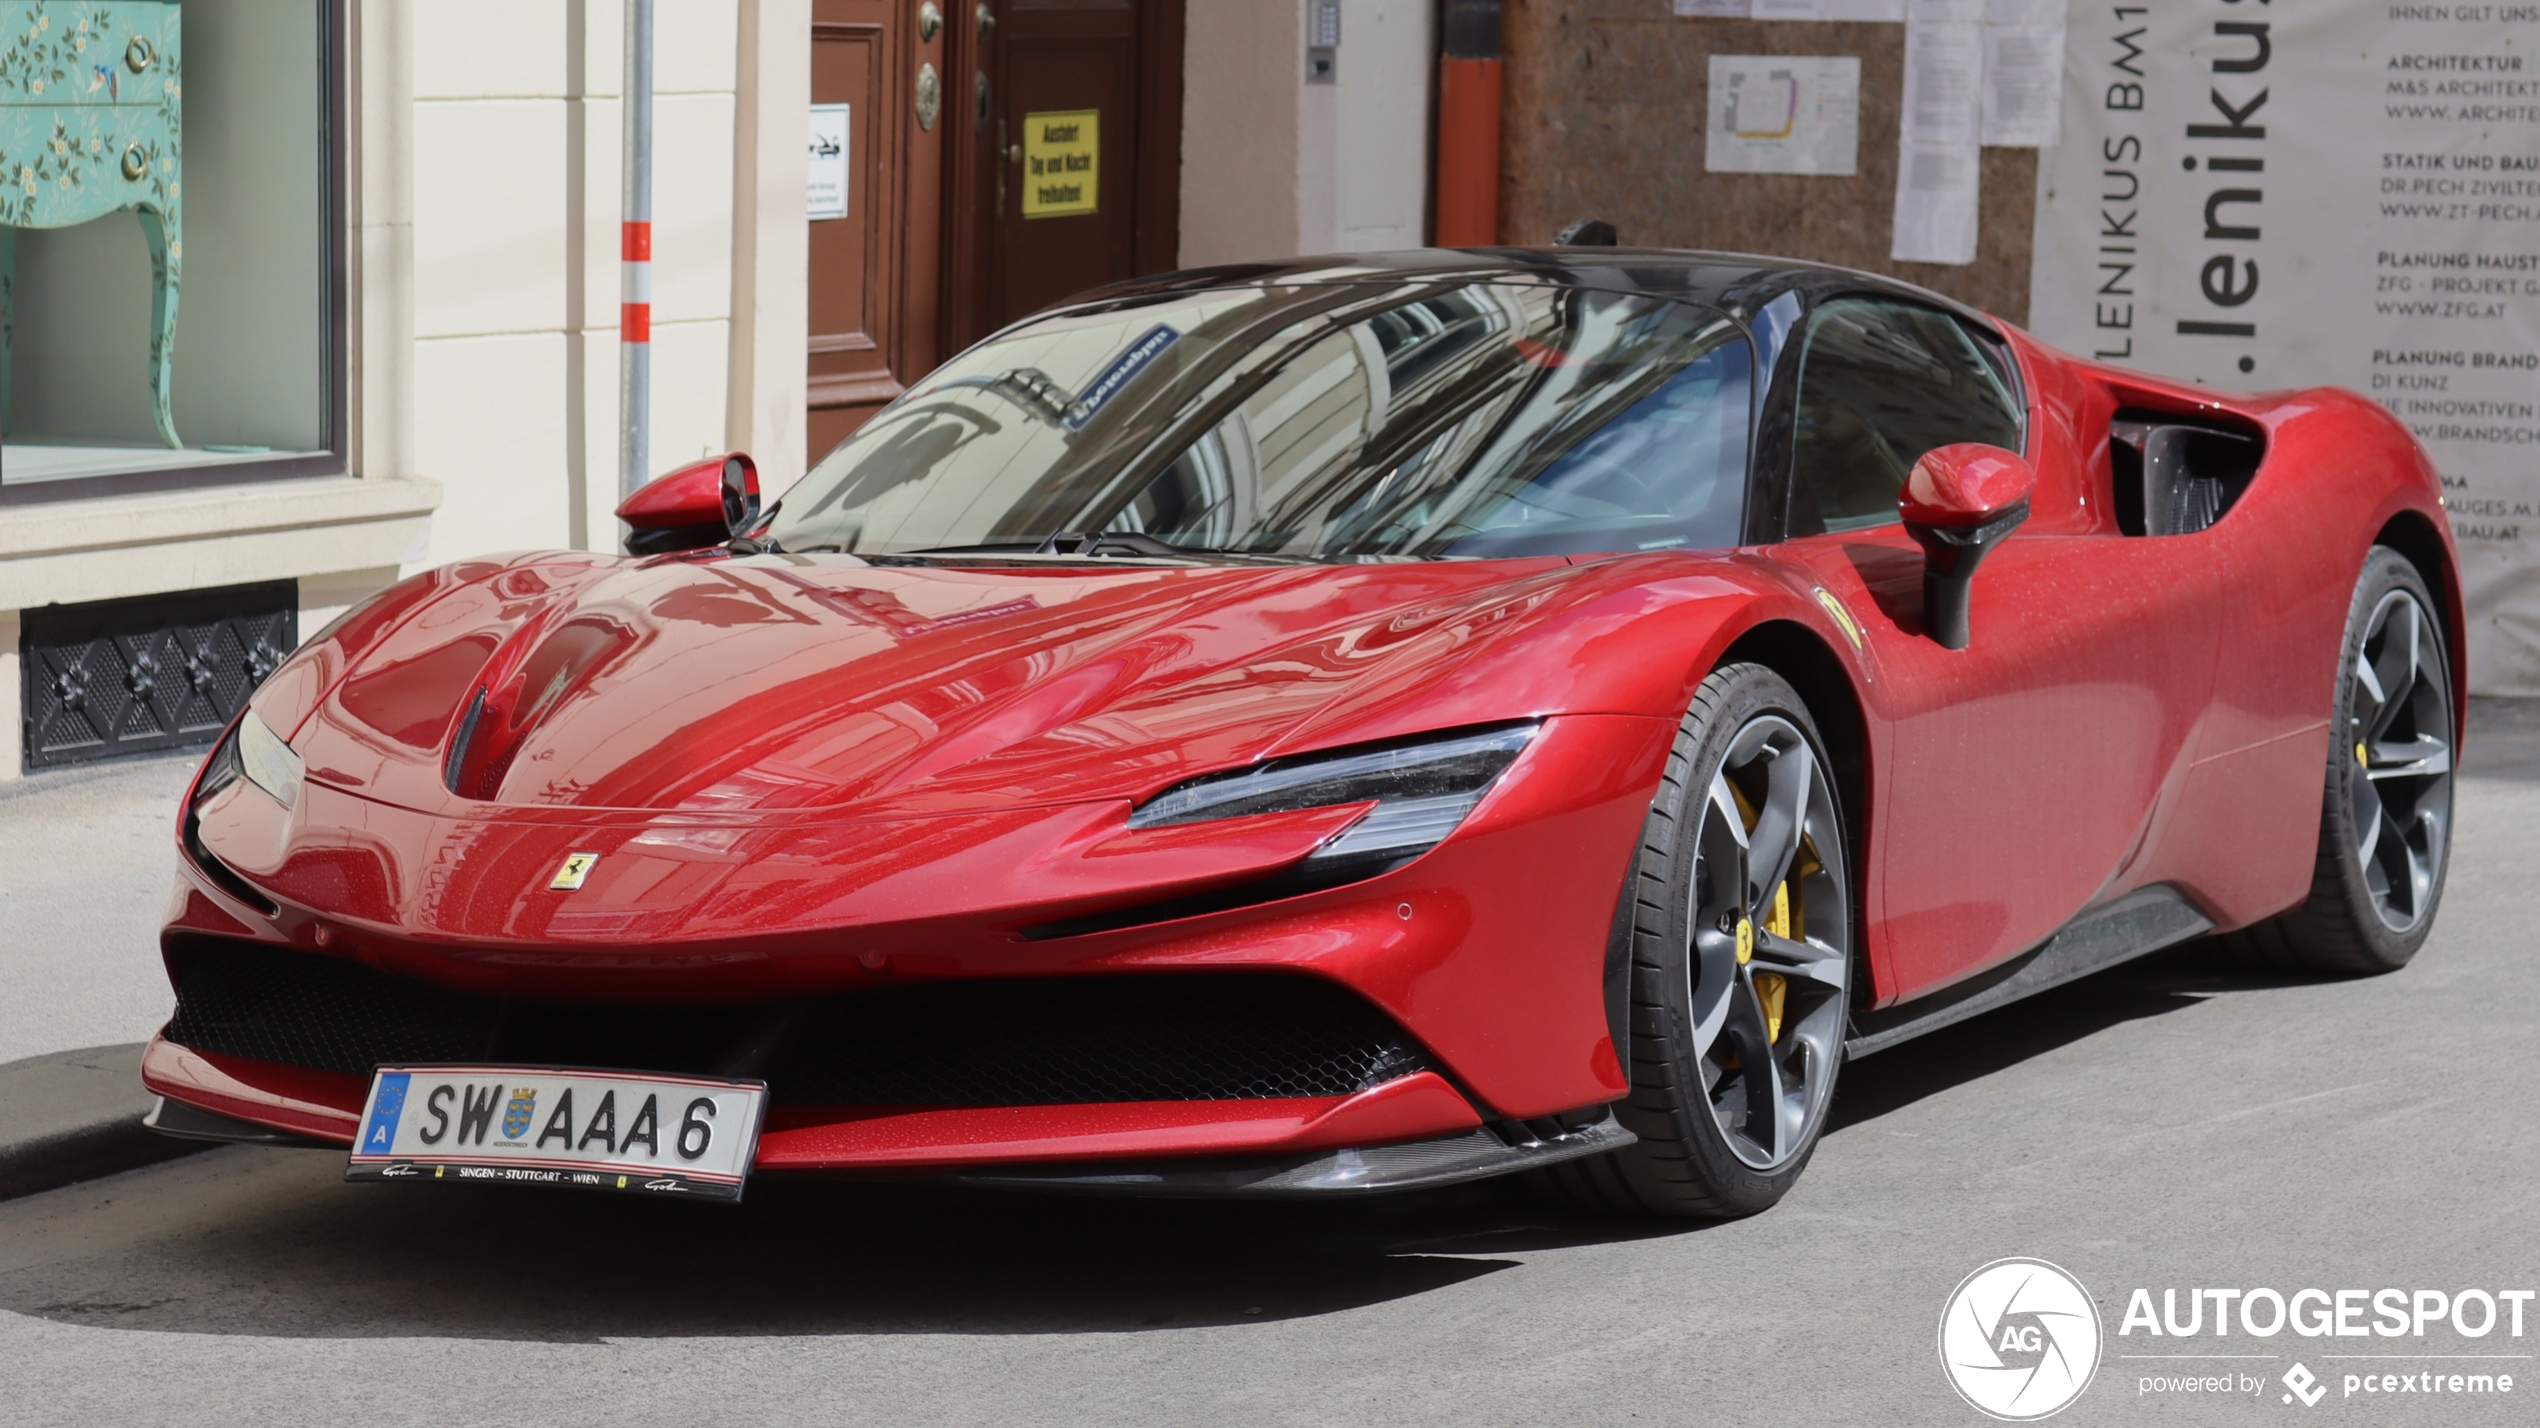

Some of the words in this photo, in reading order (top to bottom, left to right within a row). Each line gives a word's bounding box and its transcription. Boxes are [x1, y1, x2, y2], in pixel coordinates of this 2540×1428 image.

[2389, 5, 2449, 21] IHNEN
[2455, 5, 2491, 22] GILT
[2500, 5, 2540, 22] UNS
[2106, 8, 2148, 110] BM1
[2387, 54, 2522, 71] ARCHITEKTUR
[2385, 79, 2429, 95] M&S
[1043, 123, 1079, 143] Ausfahrt
[1031, 154, 1043, 177] Tag
[1047, 154, 1062, 173] und
[1066, 154, 1090, 171] Nacht
[2382, 153, 2445, 169] STATIK
[2453, 154, 2493, 171] UND
[2501, 155, 2540, 172] BAU
[2177, 0, 2271, 373] .leniku
[2380, 178, 2464, 195] DR.PECH
[2095, 135, 2141, 359] LENIKUS
[2377, 251, 2470, 269] PLANUNG
[2376, 275, 2411, 292] ZFG
[2432, 277, 2517, 294] PROJEKT
[2524, 279, 2540, 296] G
[2376, 302, 2506, 319] WWW.ZFG.AT
[2373, 350, 2465, 367] PLANUNG
[2473, 353, 2540, 370] BRAND
[2372, 373, 2391, 389] DI
[2398, 374, 2449, 391] KUNZ
[2409, 401, 2533, 418] INNOVATIVEN
[2452, 523, 2520, 541] BAU.AT
[372, 1125, 386, 1143] A
[420, 1084, 503, 1145] SW
[459, 1167, 495, 1178] SINGEN
[505, 1168, 561, 1182] STUTTGART
[572, 1174, 600, 1185] WIEN
